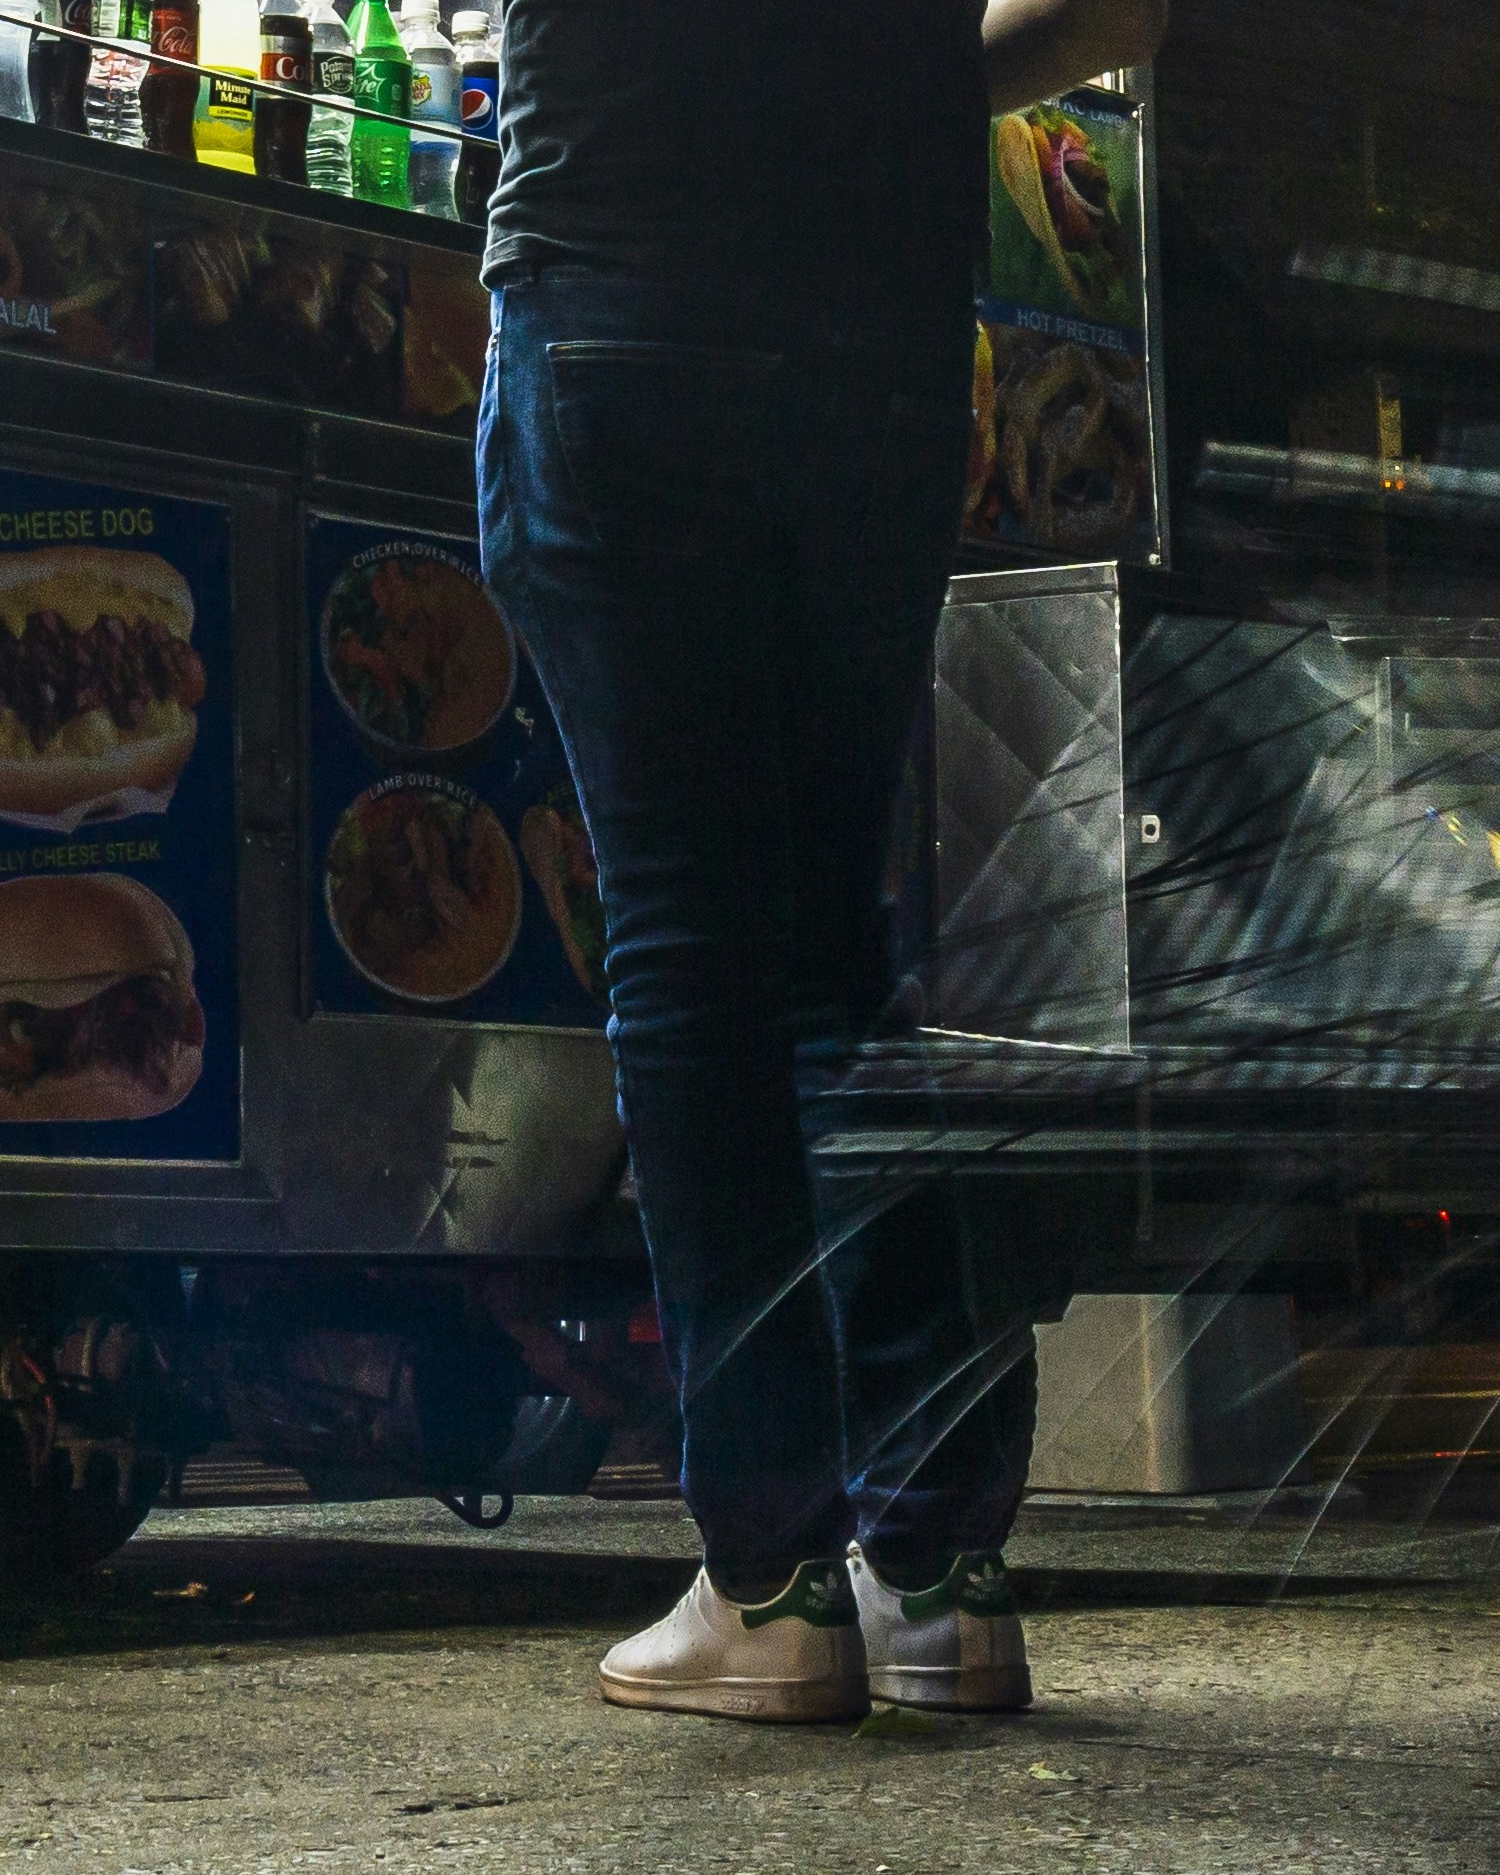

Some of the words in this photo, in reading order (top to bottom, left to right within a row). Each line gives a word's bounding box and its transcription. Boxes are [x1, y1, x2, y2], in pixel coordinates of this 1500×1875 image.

[215, 79, 252, 95] Minute
[220, 91, 248, 105] Maid
[1016, 307, 1051, 334] HOT
[1056, 317, 1128, 352] PRETZEL
[101, 507, 155, 537] DOG
[352, 541, 410, 569] CHICKEN
[367, 774, 403, 801] LAMB
[407, 771, 441, 790] OVER
[446, 780, 477, 809] RICE
[31, 843, 102, 869] CHEESE
[104, 839, 161, 864] STEAK
